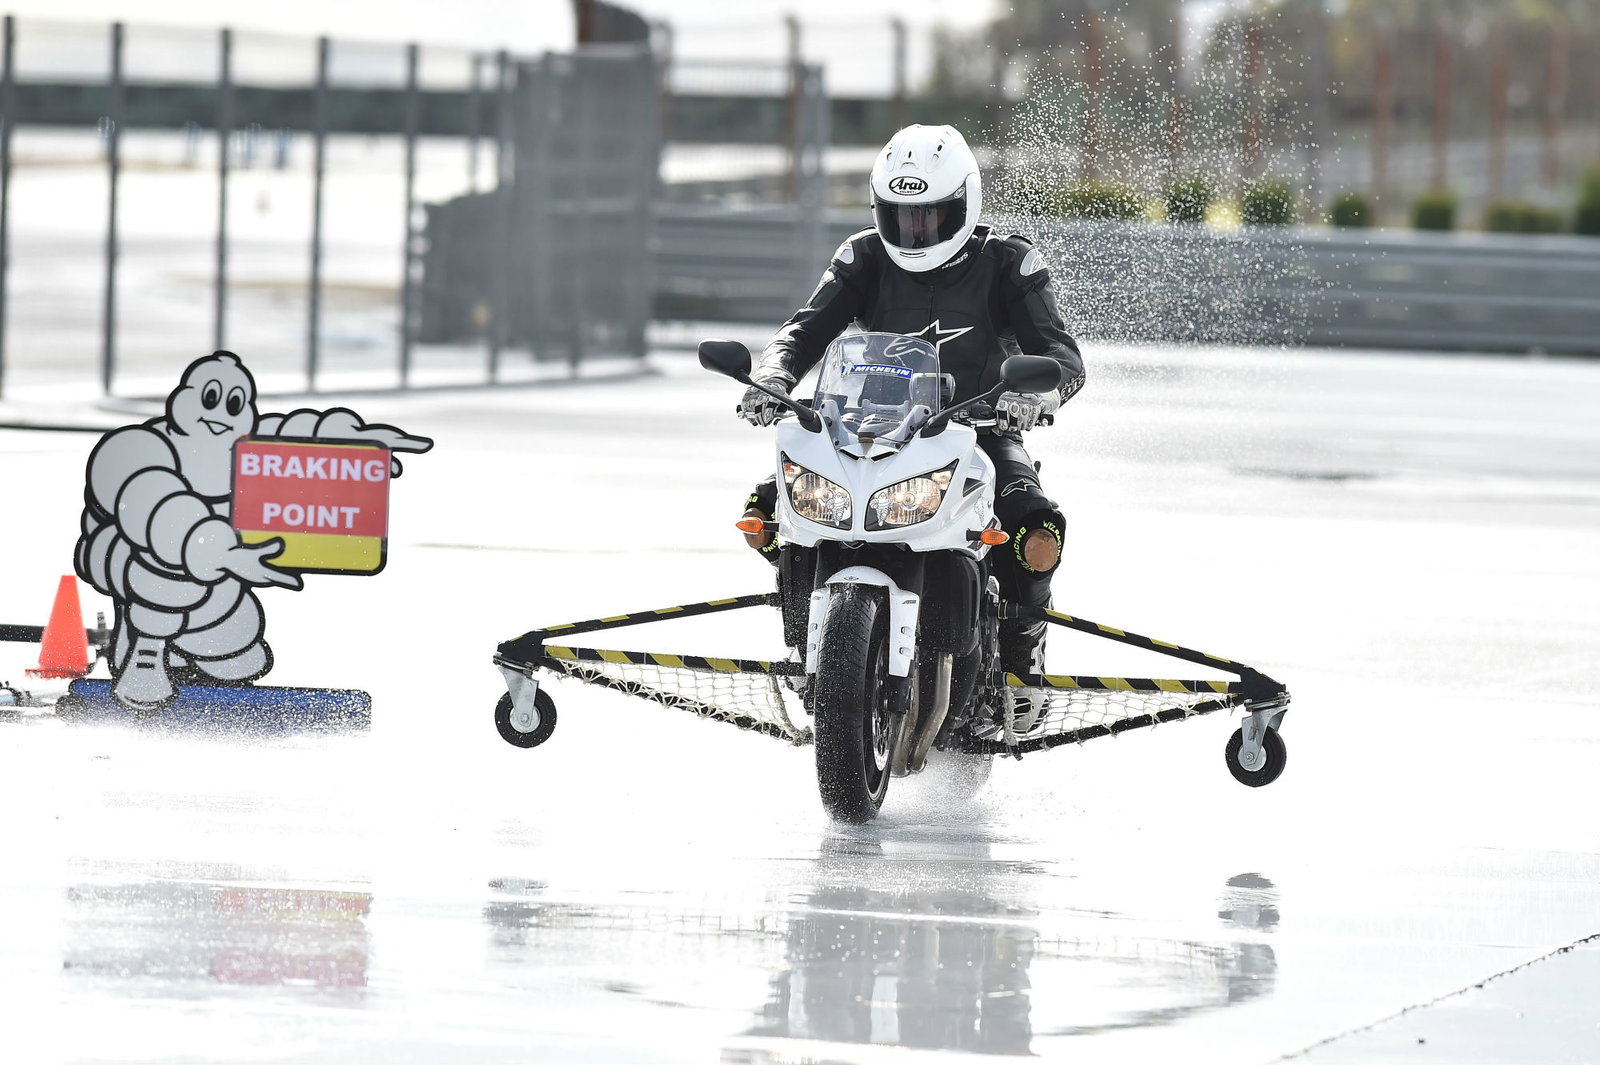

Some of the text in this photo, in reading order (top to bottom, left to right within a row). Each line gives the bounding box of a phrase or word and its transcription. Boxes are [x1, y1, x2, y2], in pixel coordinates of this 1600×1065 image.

[891, 178, 923, 190] Arai
[854, 366, 910, 375] MICHELIN
[240, 453, 385, 482] BRAKING
[262, 502, 360, 529] POINT
[1013, 526, 1027, 561] RACING
